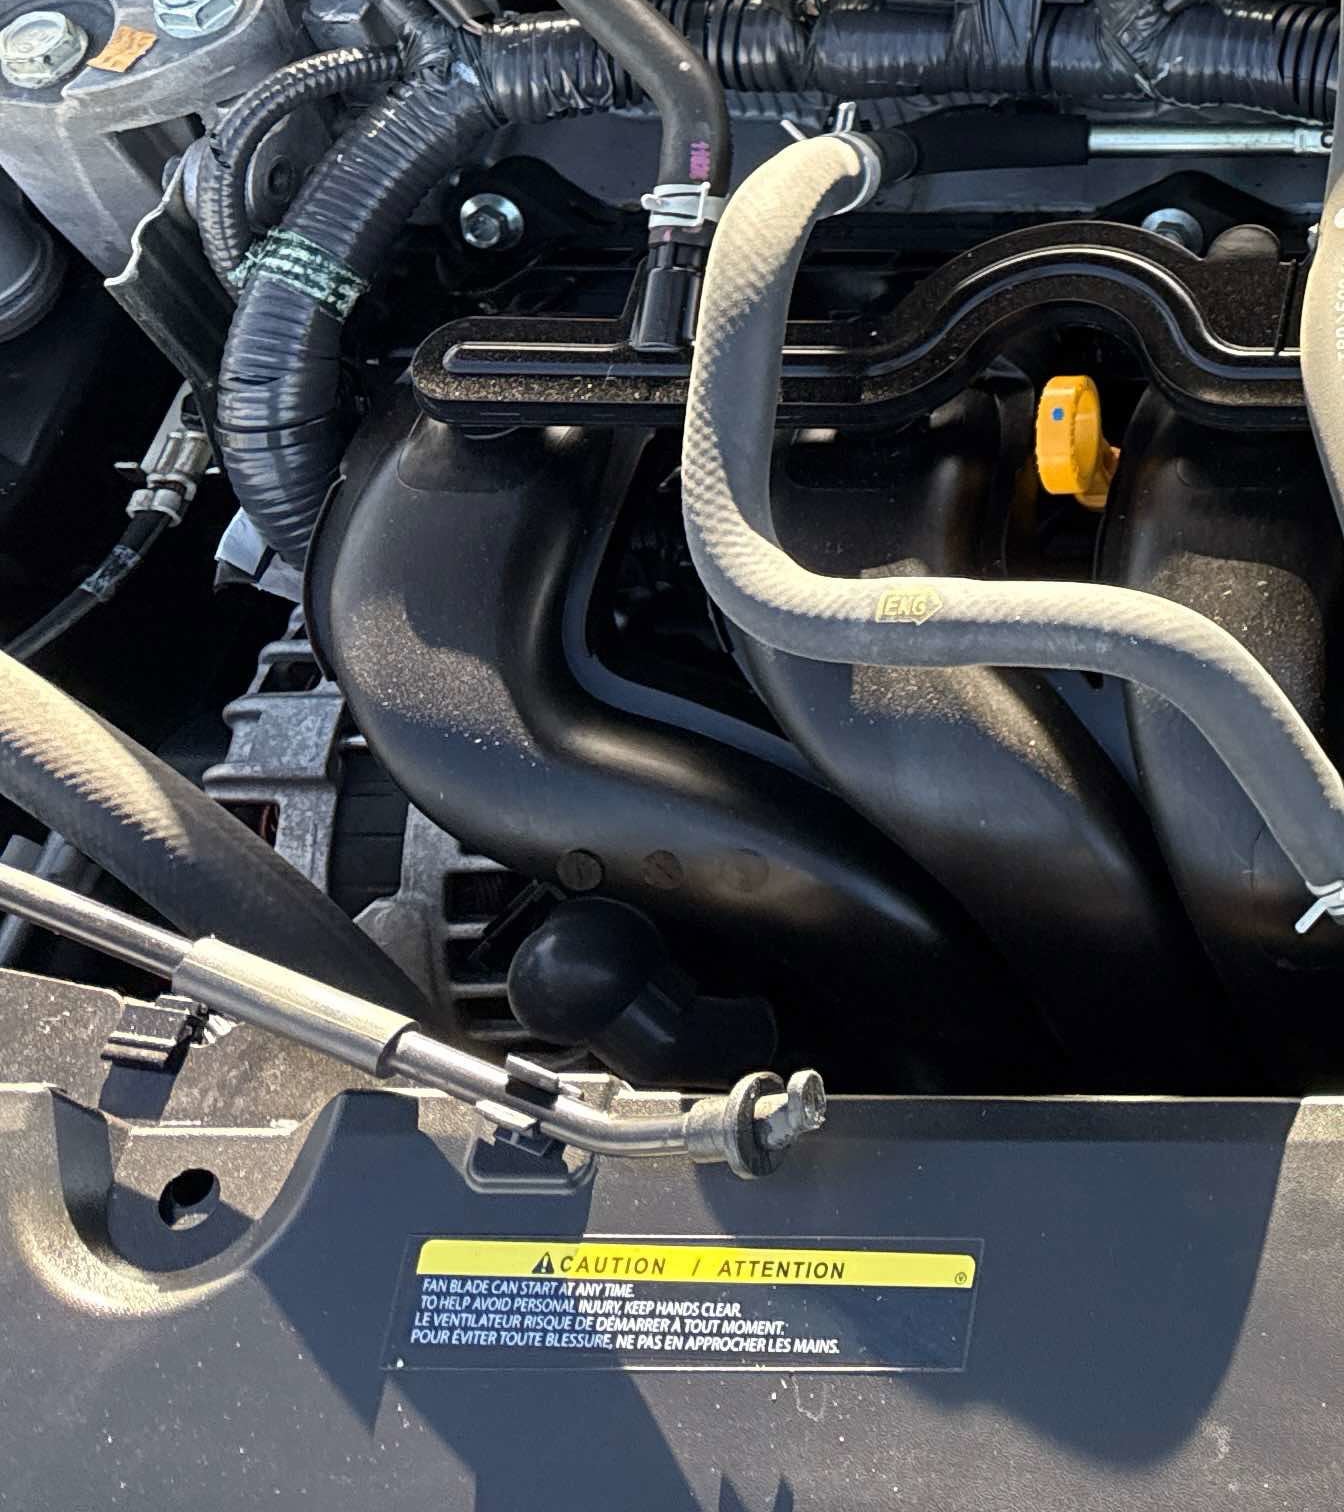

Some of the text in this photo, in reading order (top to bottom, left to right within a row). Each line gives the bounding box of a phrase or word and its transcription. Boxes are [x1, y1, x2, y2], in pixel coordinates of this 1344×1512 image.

[560, 1256, 845, 1279] CAUTION / ATTENTION
[422, 1278, 635, 1298] FAN BLADE CAN START AT ANY TIME.
[421, 1295, 438, 1309] TO
[439, 1296, 470, 1310] HELP
[472, 1297, 511, 1311] AVOID
[513, 1298, 576, 1313] PERSONAL
[578, 1300, 622, 1316] INJURY,
[623, 1301, 654, 1316] KEEP
[655, 1302, 699, 1317] HANDS
[414, 1312, 785, 1336] LE VENTILATEUR RISQUE DE DÉMARRER À TOUT MOMENT.
[410, 1328, 840, 1354] POUR ÉVITER TOUTE BLESSURE, NE PAS EN APPROCHER LES MAINS.
